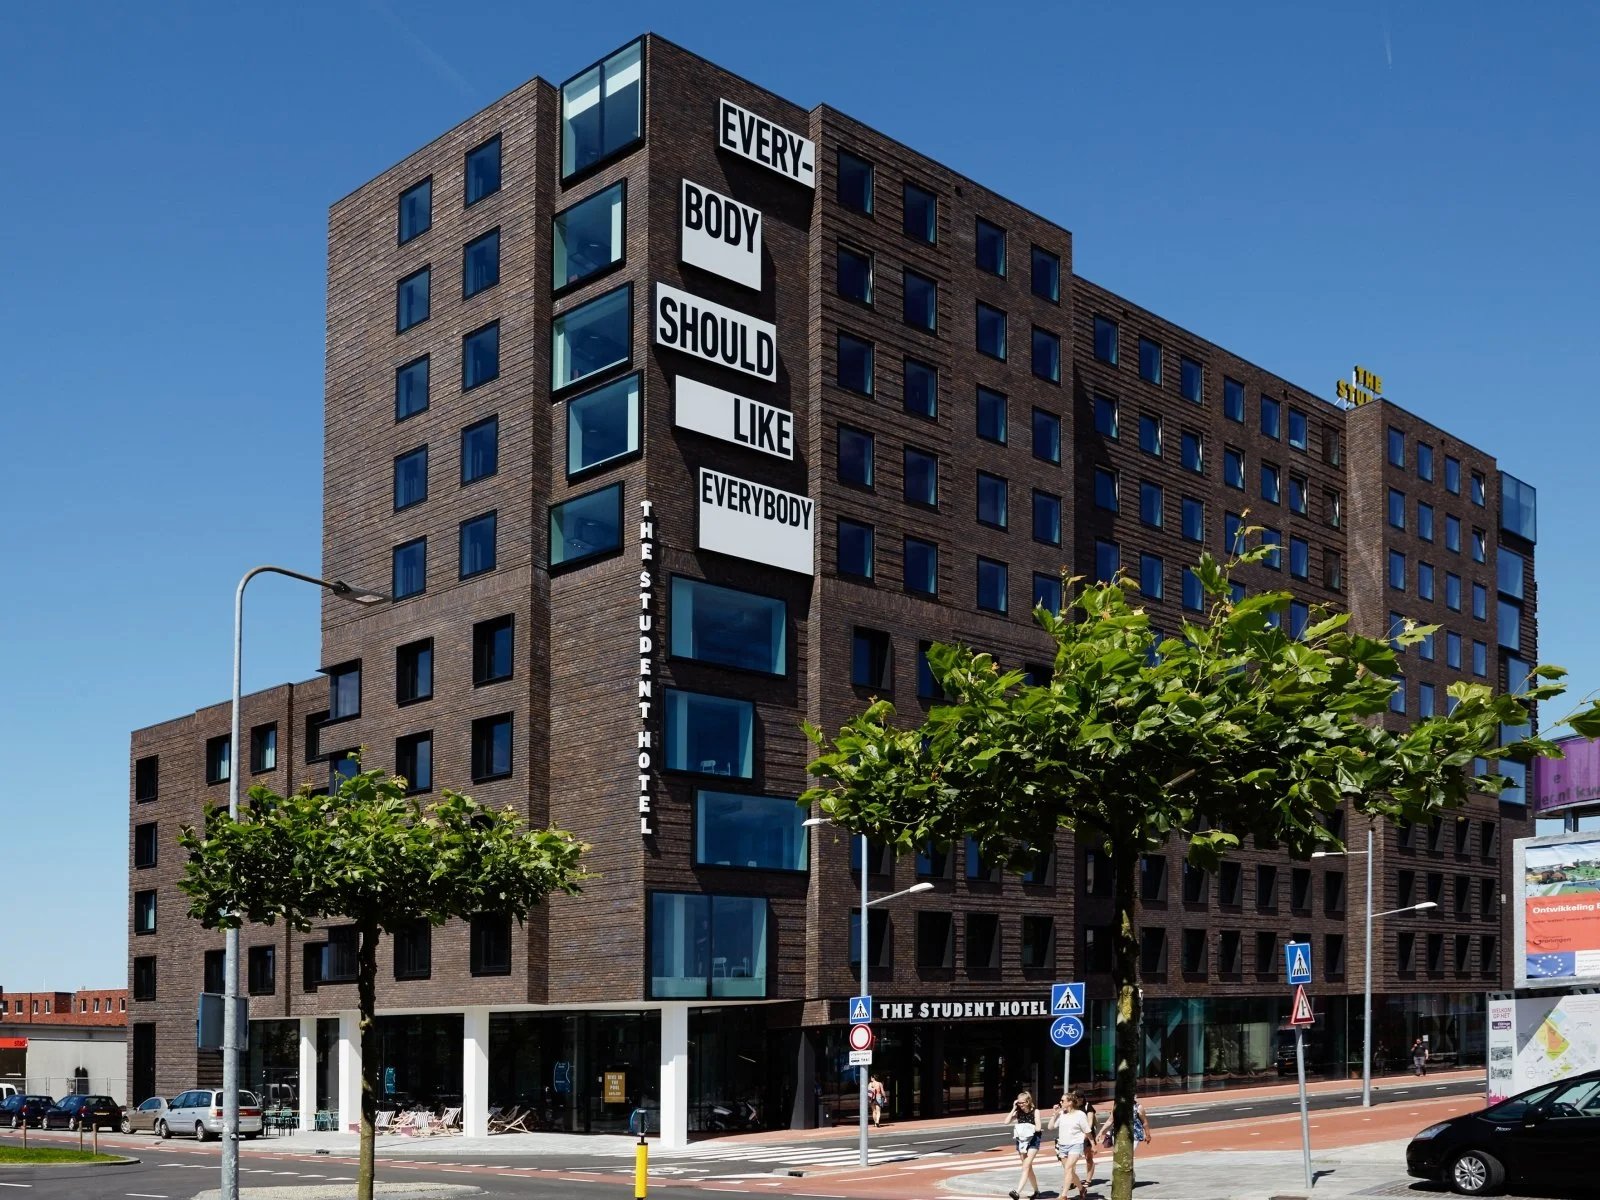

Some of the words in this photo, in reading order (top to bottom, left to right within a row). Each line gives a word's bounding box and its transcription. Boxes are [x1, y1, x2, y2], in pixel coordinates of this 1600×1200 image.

[722, 102, 814, 178] EVERY-
[684, 183, 760, 254] BODY
[659, 296, 774, 377] SHOULD
[1354, 365, 1383, 394] THE
[733, 397, 791, 457] LIKE
[639, 500, 653, 561] THE
[702, 471, 813, 531] EVERYBODY
[638, 571, 653, 720] STUDENT
[638, 731, 653, 835] HOTEL
[1532, 904, 1595, 914] Ontwikkeling
[880, 1003, 914, 1019] THE
[919, 1002, 995, 1018] STUDENT
[999, 1001, 1048, 1016] HOTEL
